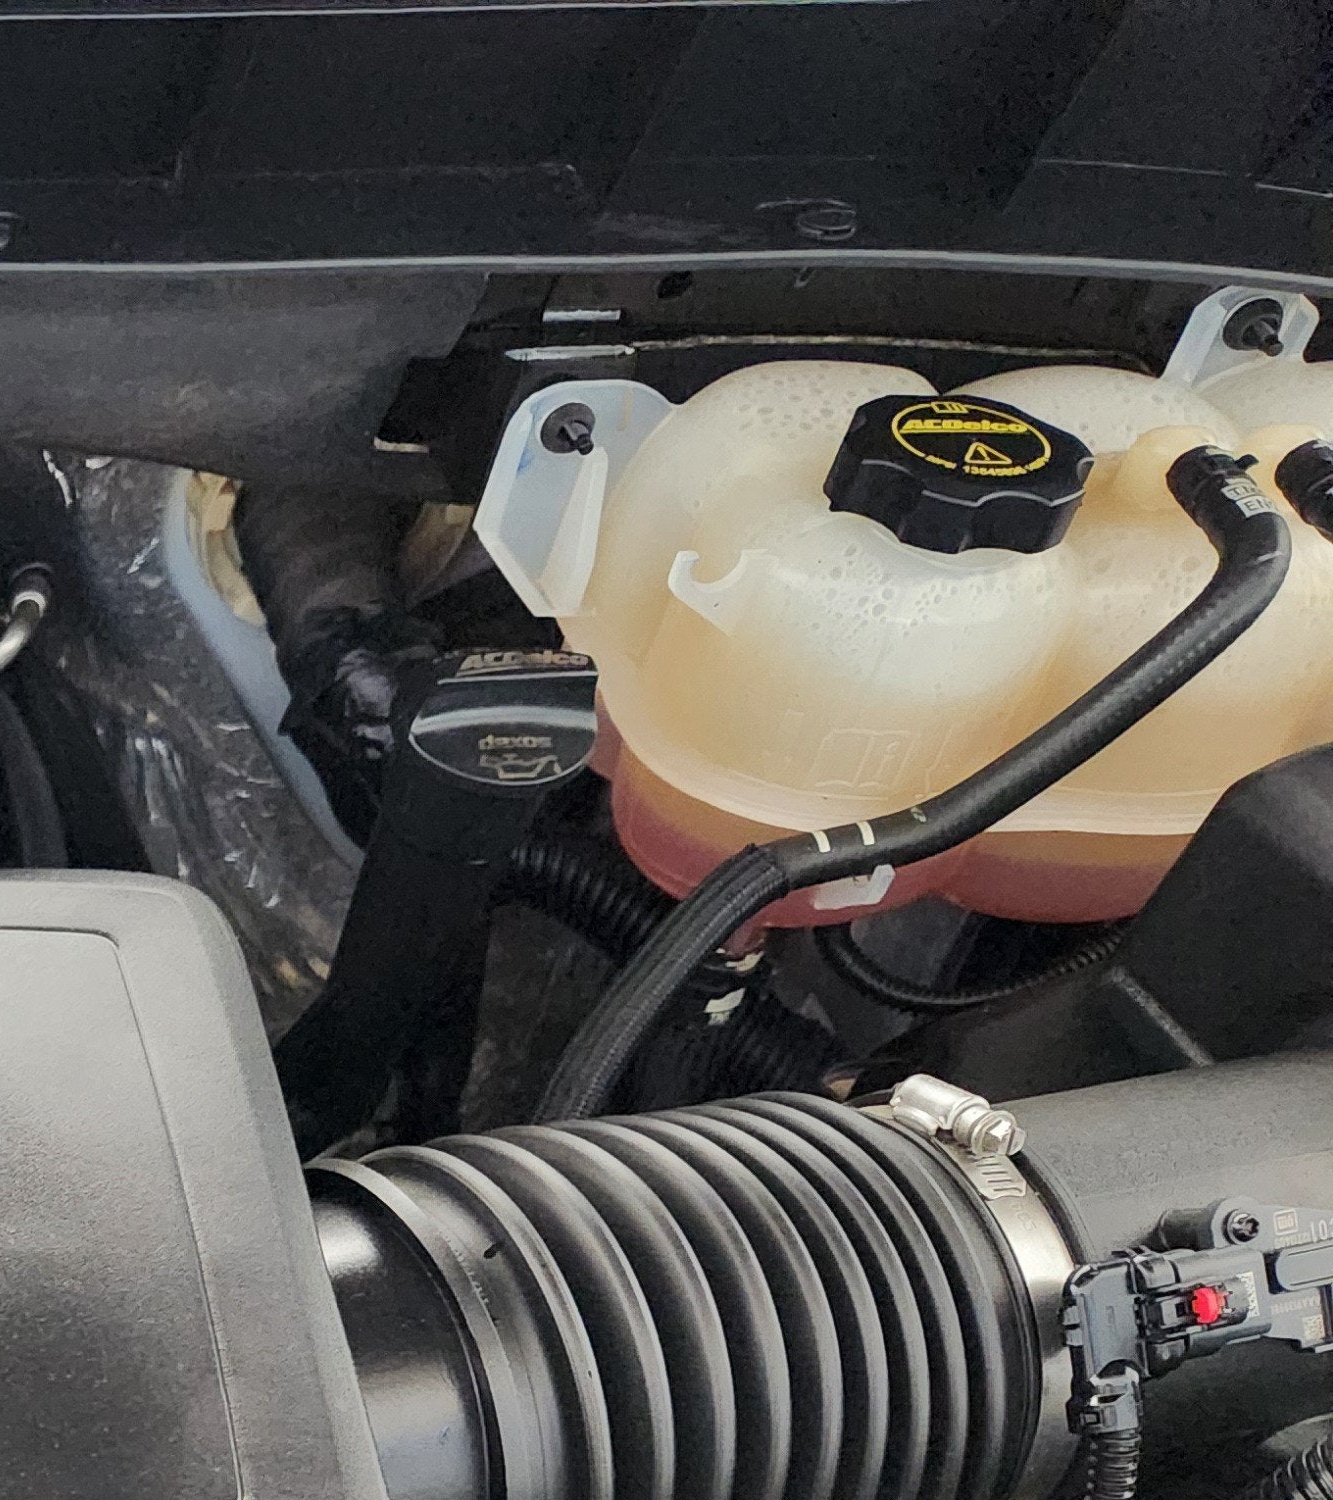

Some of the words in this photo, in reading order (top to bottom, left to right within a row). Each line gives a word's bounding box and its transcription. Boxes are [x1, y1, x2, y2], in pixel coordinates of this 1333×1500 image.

[900, 418, 1029, 434] ACDelco
[459, 650, 589, 671] ACDelco
[478, 734, 552, 750] dexos
